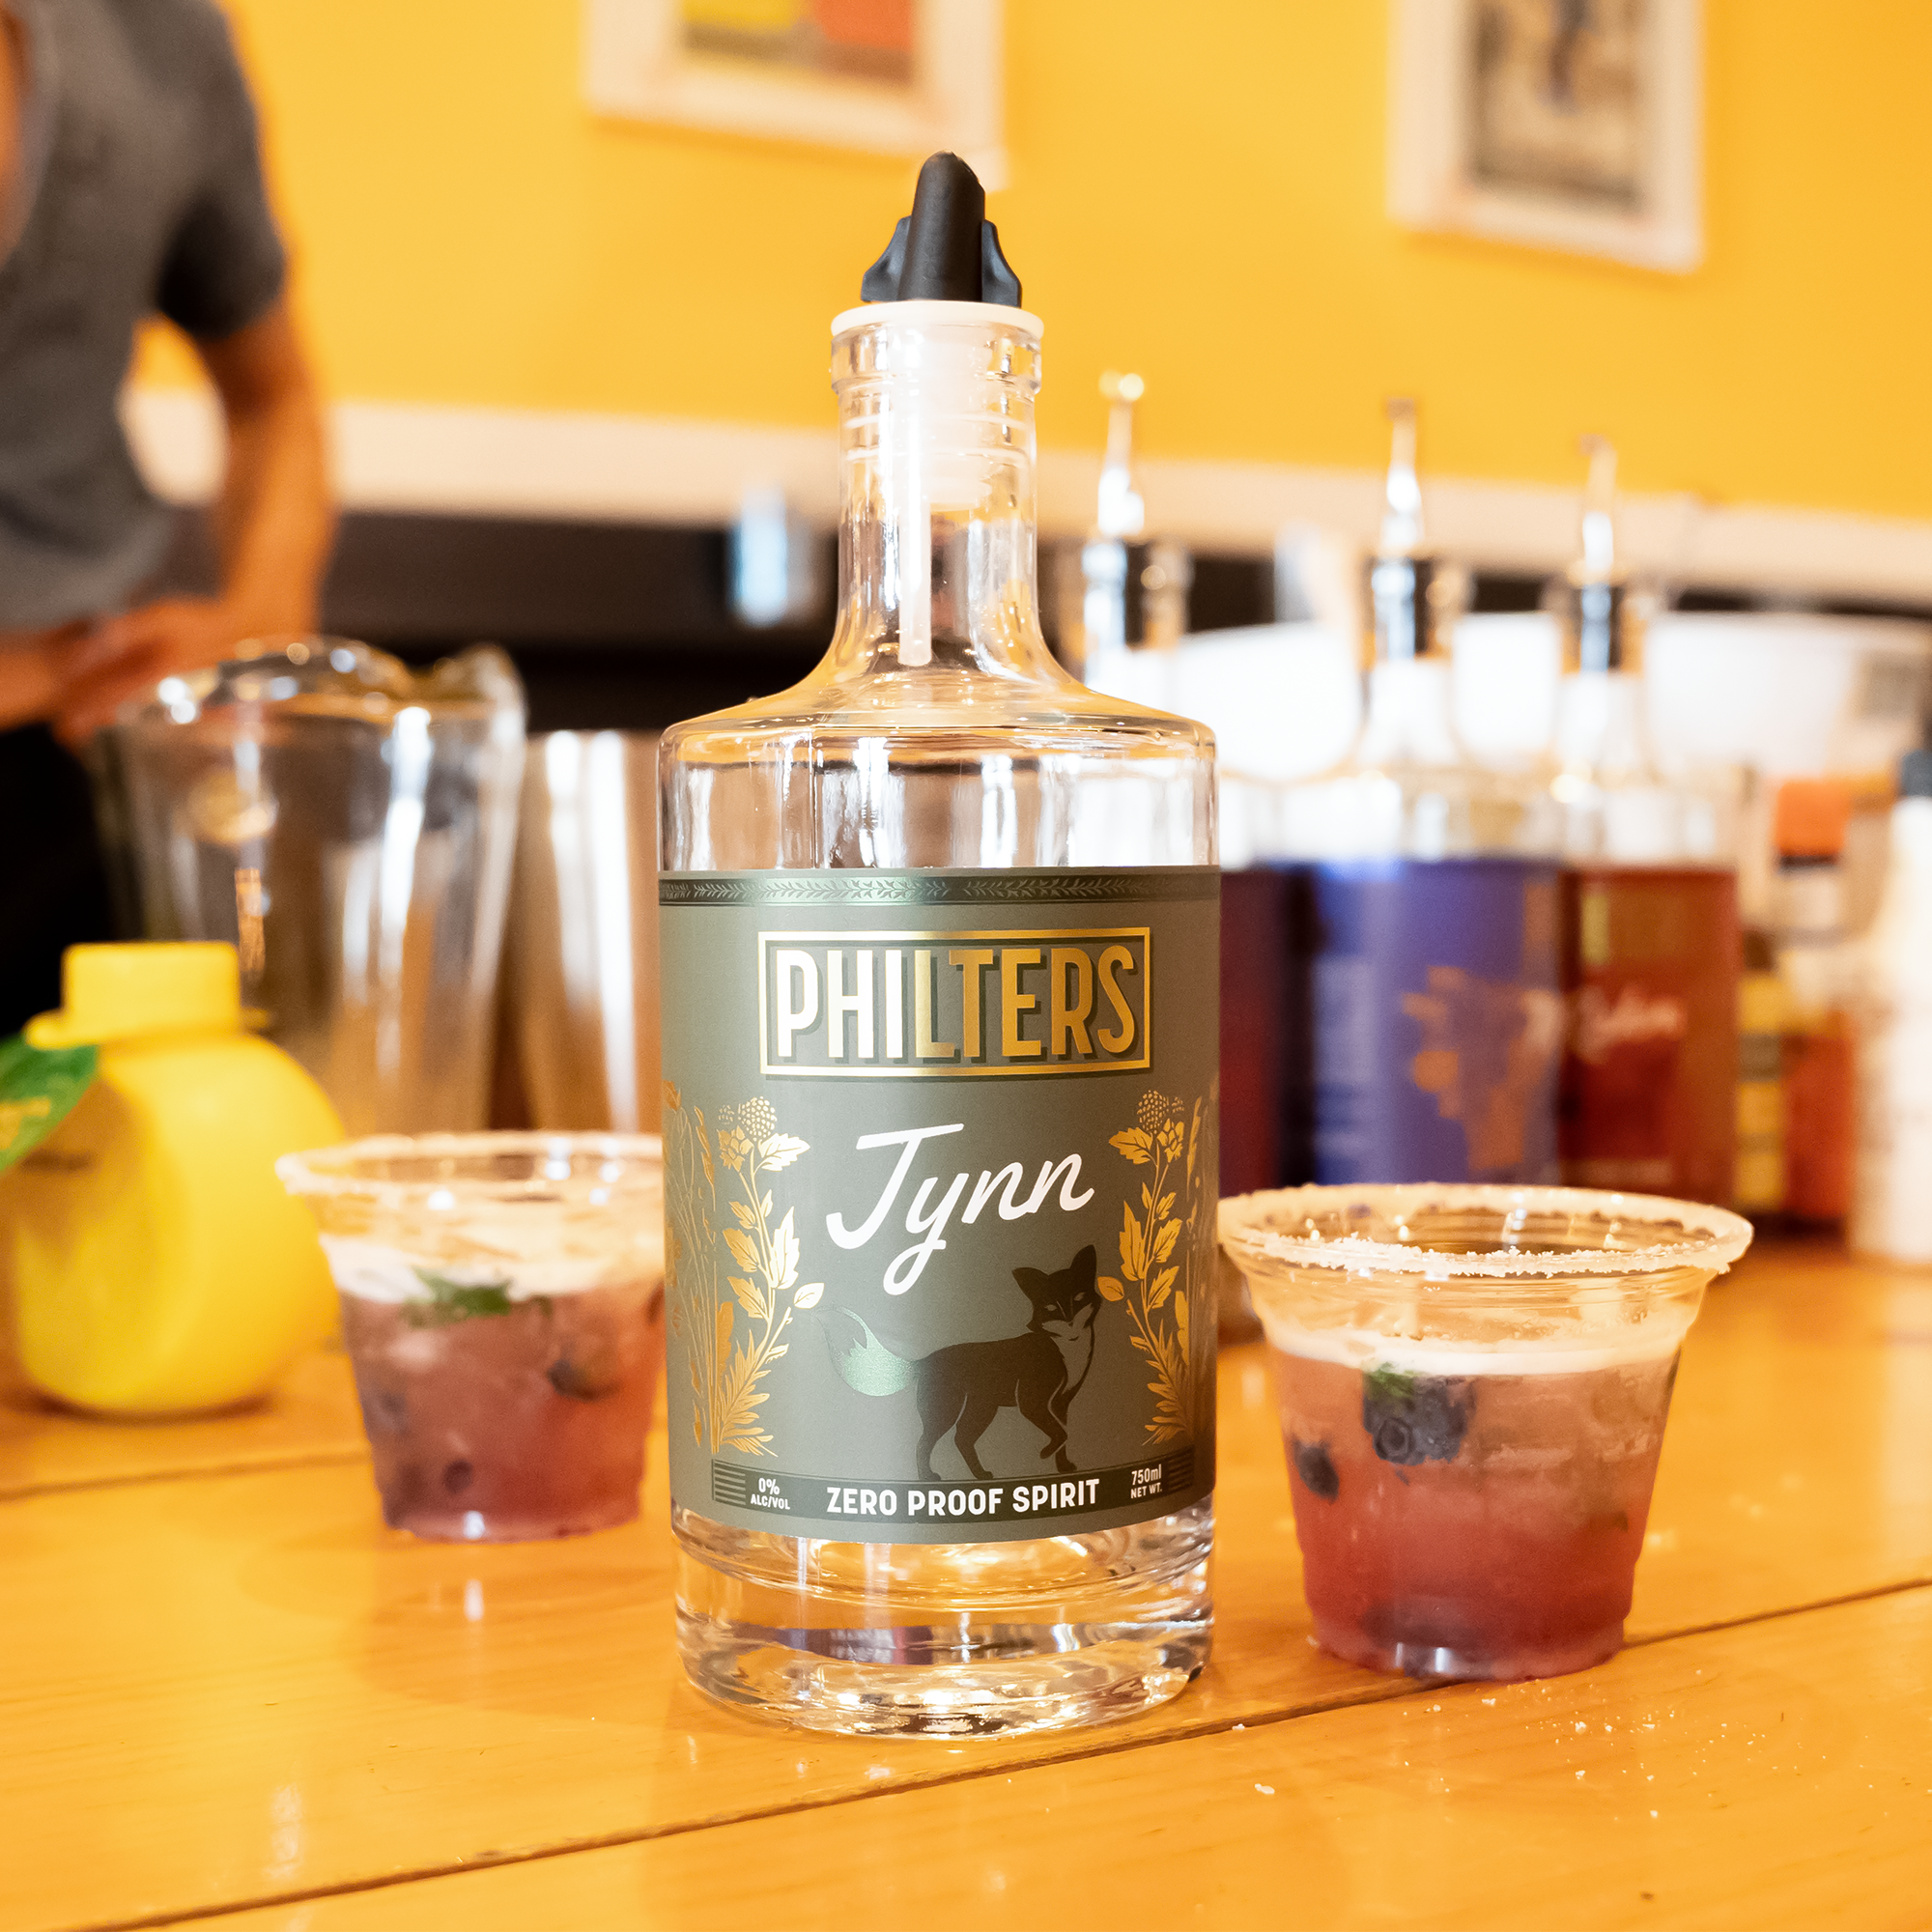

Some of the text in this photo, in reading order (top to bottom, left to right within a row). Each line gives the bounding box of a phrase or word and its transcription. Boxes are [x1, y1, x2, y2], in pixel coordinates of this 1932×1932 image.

[775, 945, 1136, 1059] PHILTERS
[1131, 1463, 1163, 1486] 750ml
[757, 1477, 781, 1495] 0%
[1130, 1485, 1147, 1499] NET
[750, 1493, 791, 1511] ALC/VOL
[826, 1478, 1100, 1517] ZERO PROOF SPIRIT
